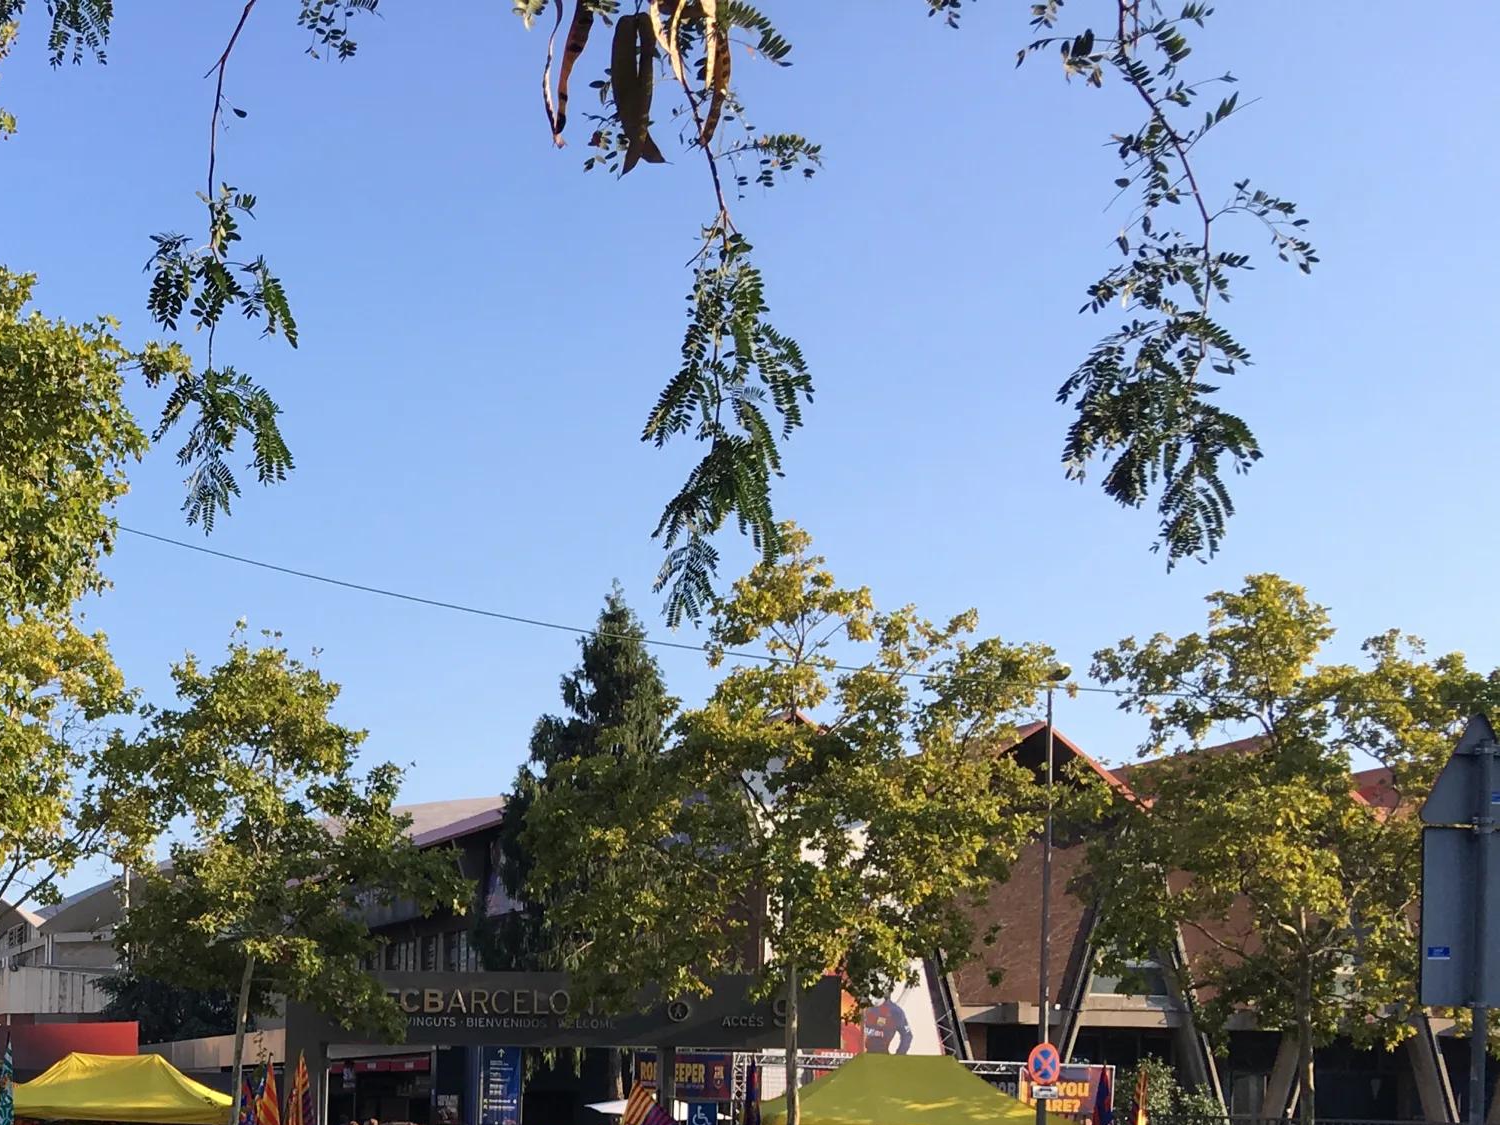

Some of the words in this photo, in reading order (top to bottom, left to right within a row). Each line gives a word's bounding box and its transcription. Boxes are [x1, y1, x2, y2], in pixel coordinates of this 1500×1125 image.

[405, 1016, 456, 1027] VINGUTS
[467, 1017, 547, 1028] BIENVENIDOS
[722, 1013, 764, 1027] ACCÉS
[1056, 1082, 1090, 1097] YOU
[1030, 1099, 1081, 1112] ARE?
